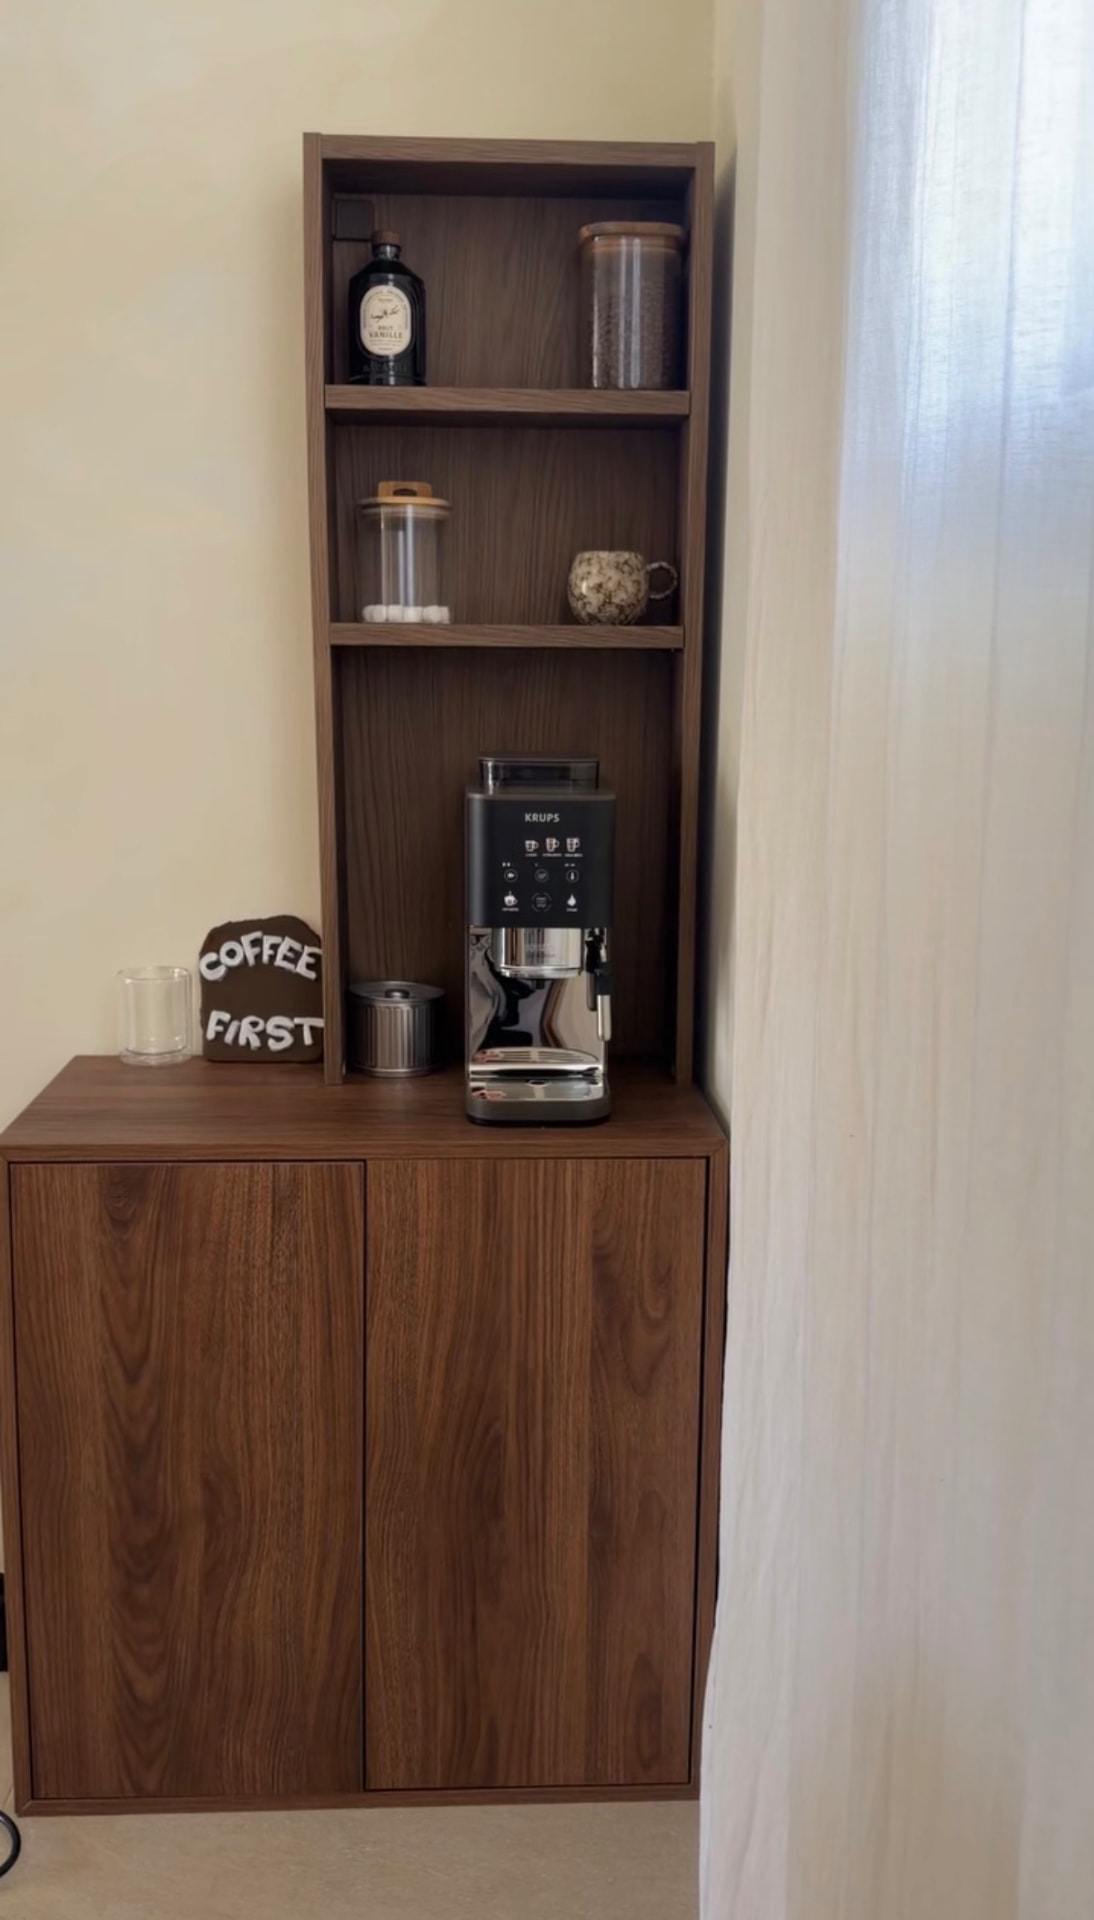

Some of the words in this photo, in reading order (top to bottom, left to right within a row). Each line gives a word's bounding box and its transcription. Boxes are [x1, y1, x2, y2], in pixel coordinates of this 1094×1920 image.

[369, 331, 403, 339] VANILLE
[524, 812, 560, 823] KRUPS
[199, 931, 322, 981] COFFEE
[206, 1009, 324, 1052] FIRST
